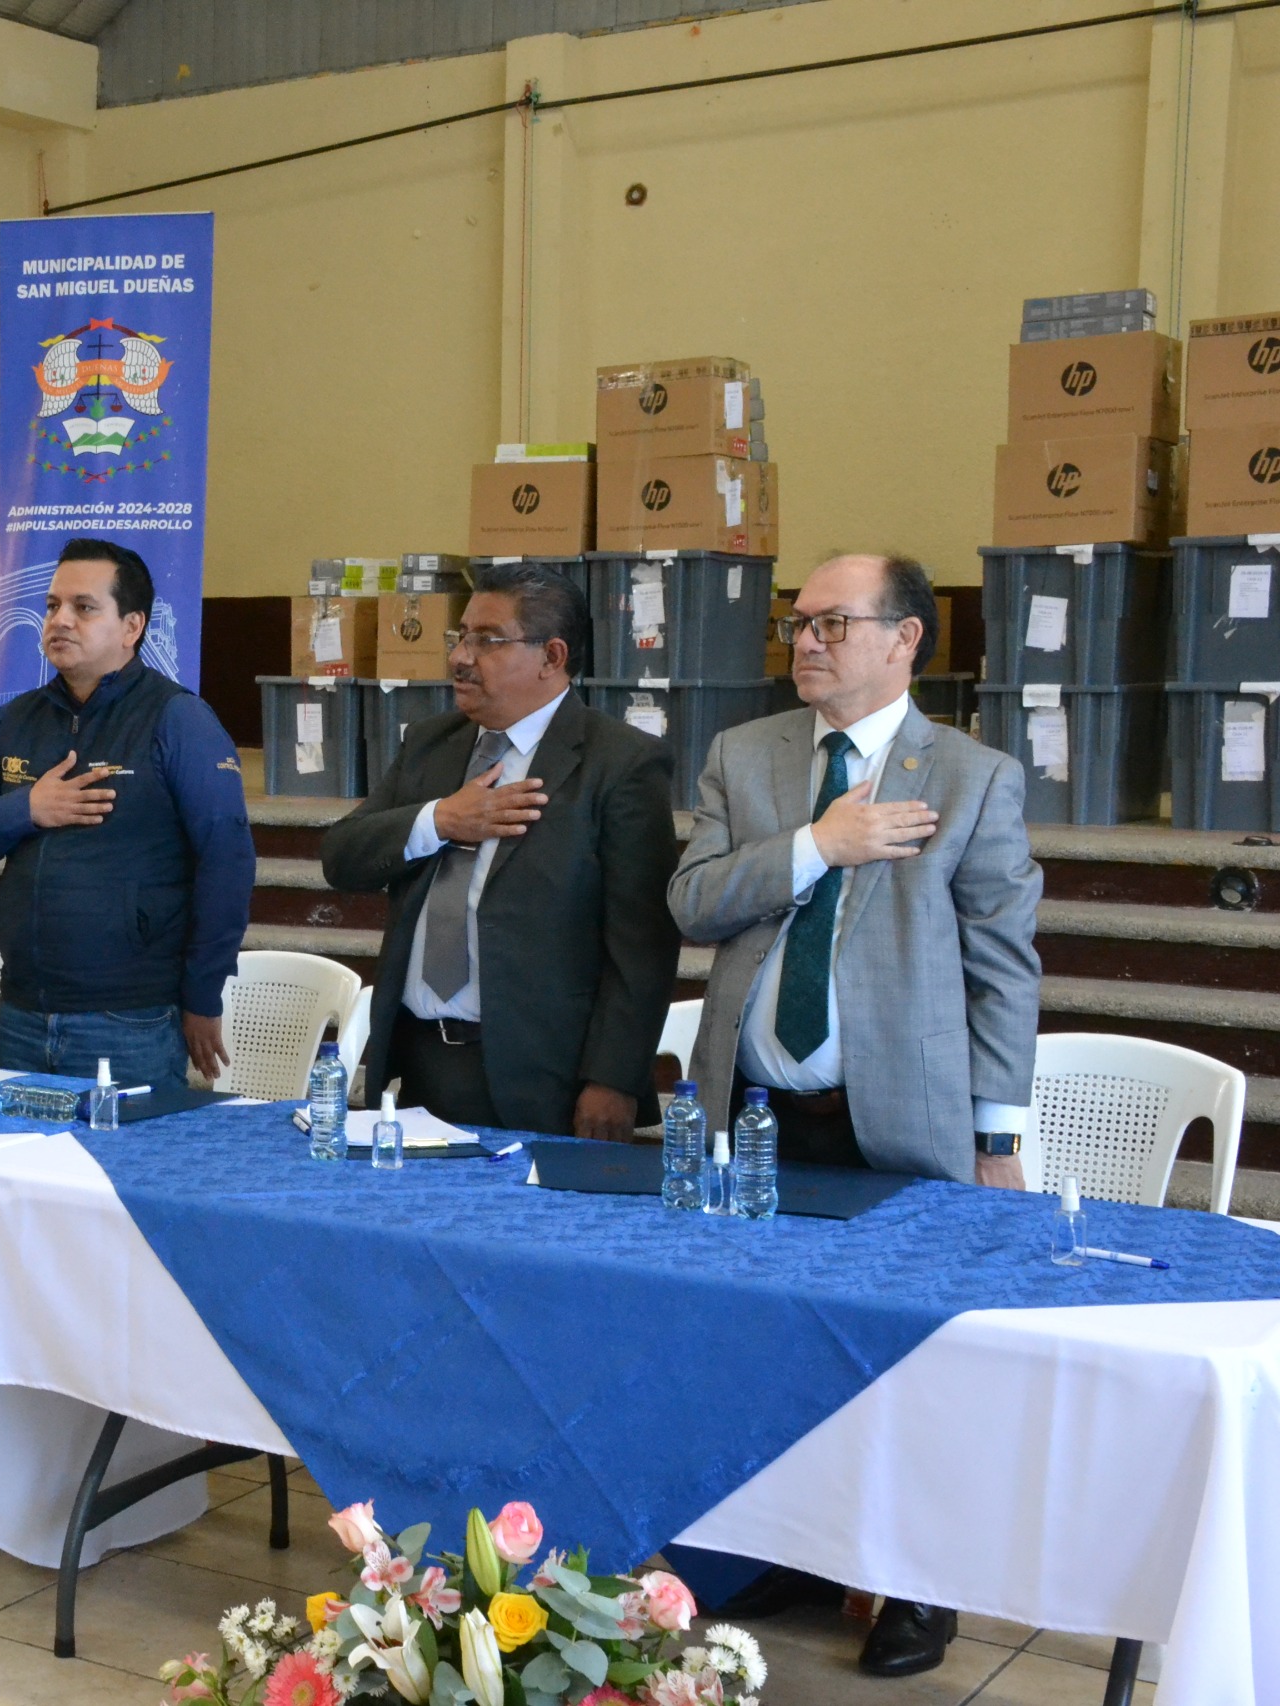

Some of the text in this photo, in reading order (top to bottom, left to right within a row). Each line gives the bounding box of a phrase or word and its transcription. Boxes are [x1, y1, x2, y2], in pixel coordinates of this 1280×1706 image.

[22, 254, 185, 275] MUNICIPALIDAD DE
[16, 275, 195, 299] SAN MIGUEL DUEÑAS
[8, 502, 192, 518] ADMINISTRACIÓN 2024-2028
[5, 518, 193, 534] #IMPULSANDOELDESARROLLO
